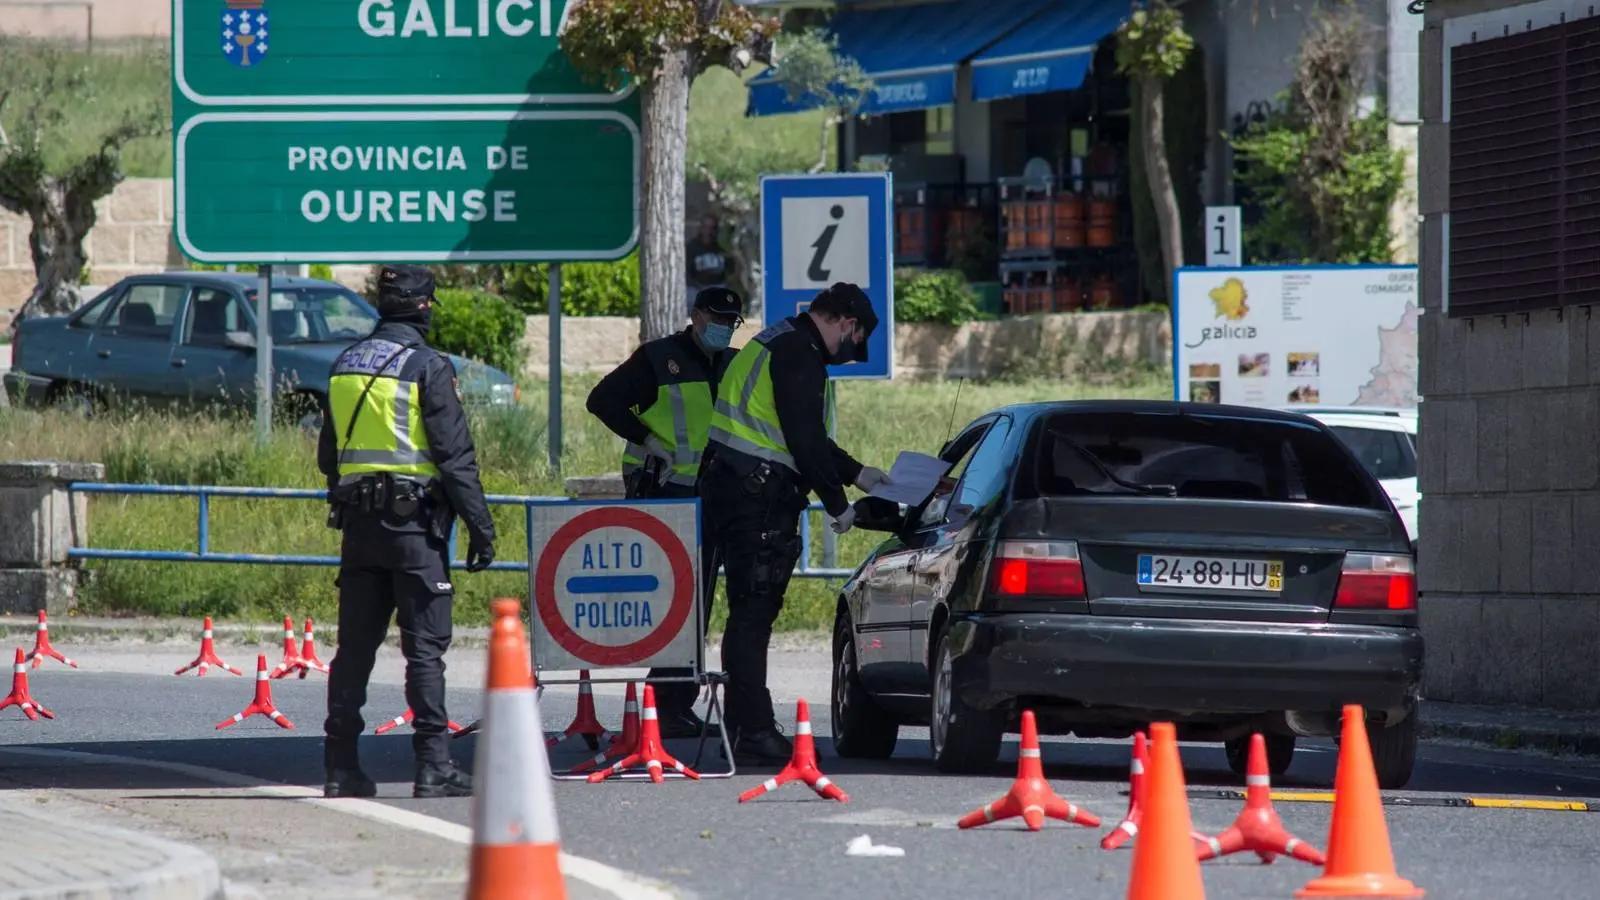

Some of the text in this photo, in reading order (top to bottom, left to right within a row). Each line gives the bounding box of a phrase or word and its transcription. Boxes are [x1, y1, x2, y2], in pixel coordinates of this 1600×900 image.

[288, 146, 528, 171] PROVINCIA DE
[300, 189, 517, 222] OURENSE
[1185, 324, 1257, 348] galicia
[342, 352, 401, 371] POLICA
[582, 542, 642, 570] ALTO
[575, 601, 652, 628] POLICIA
